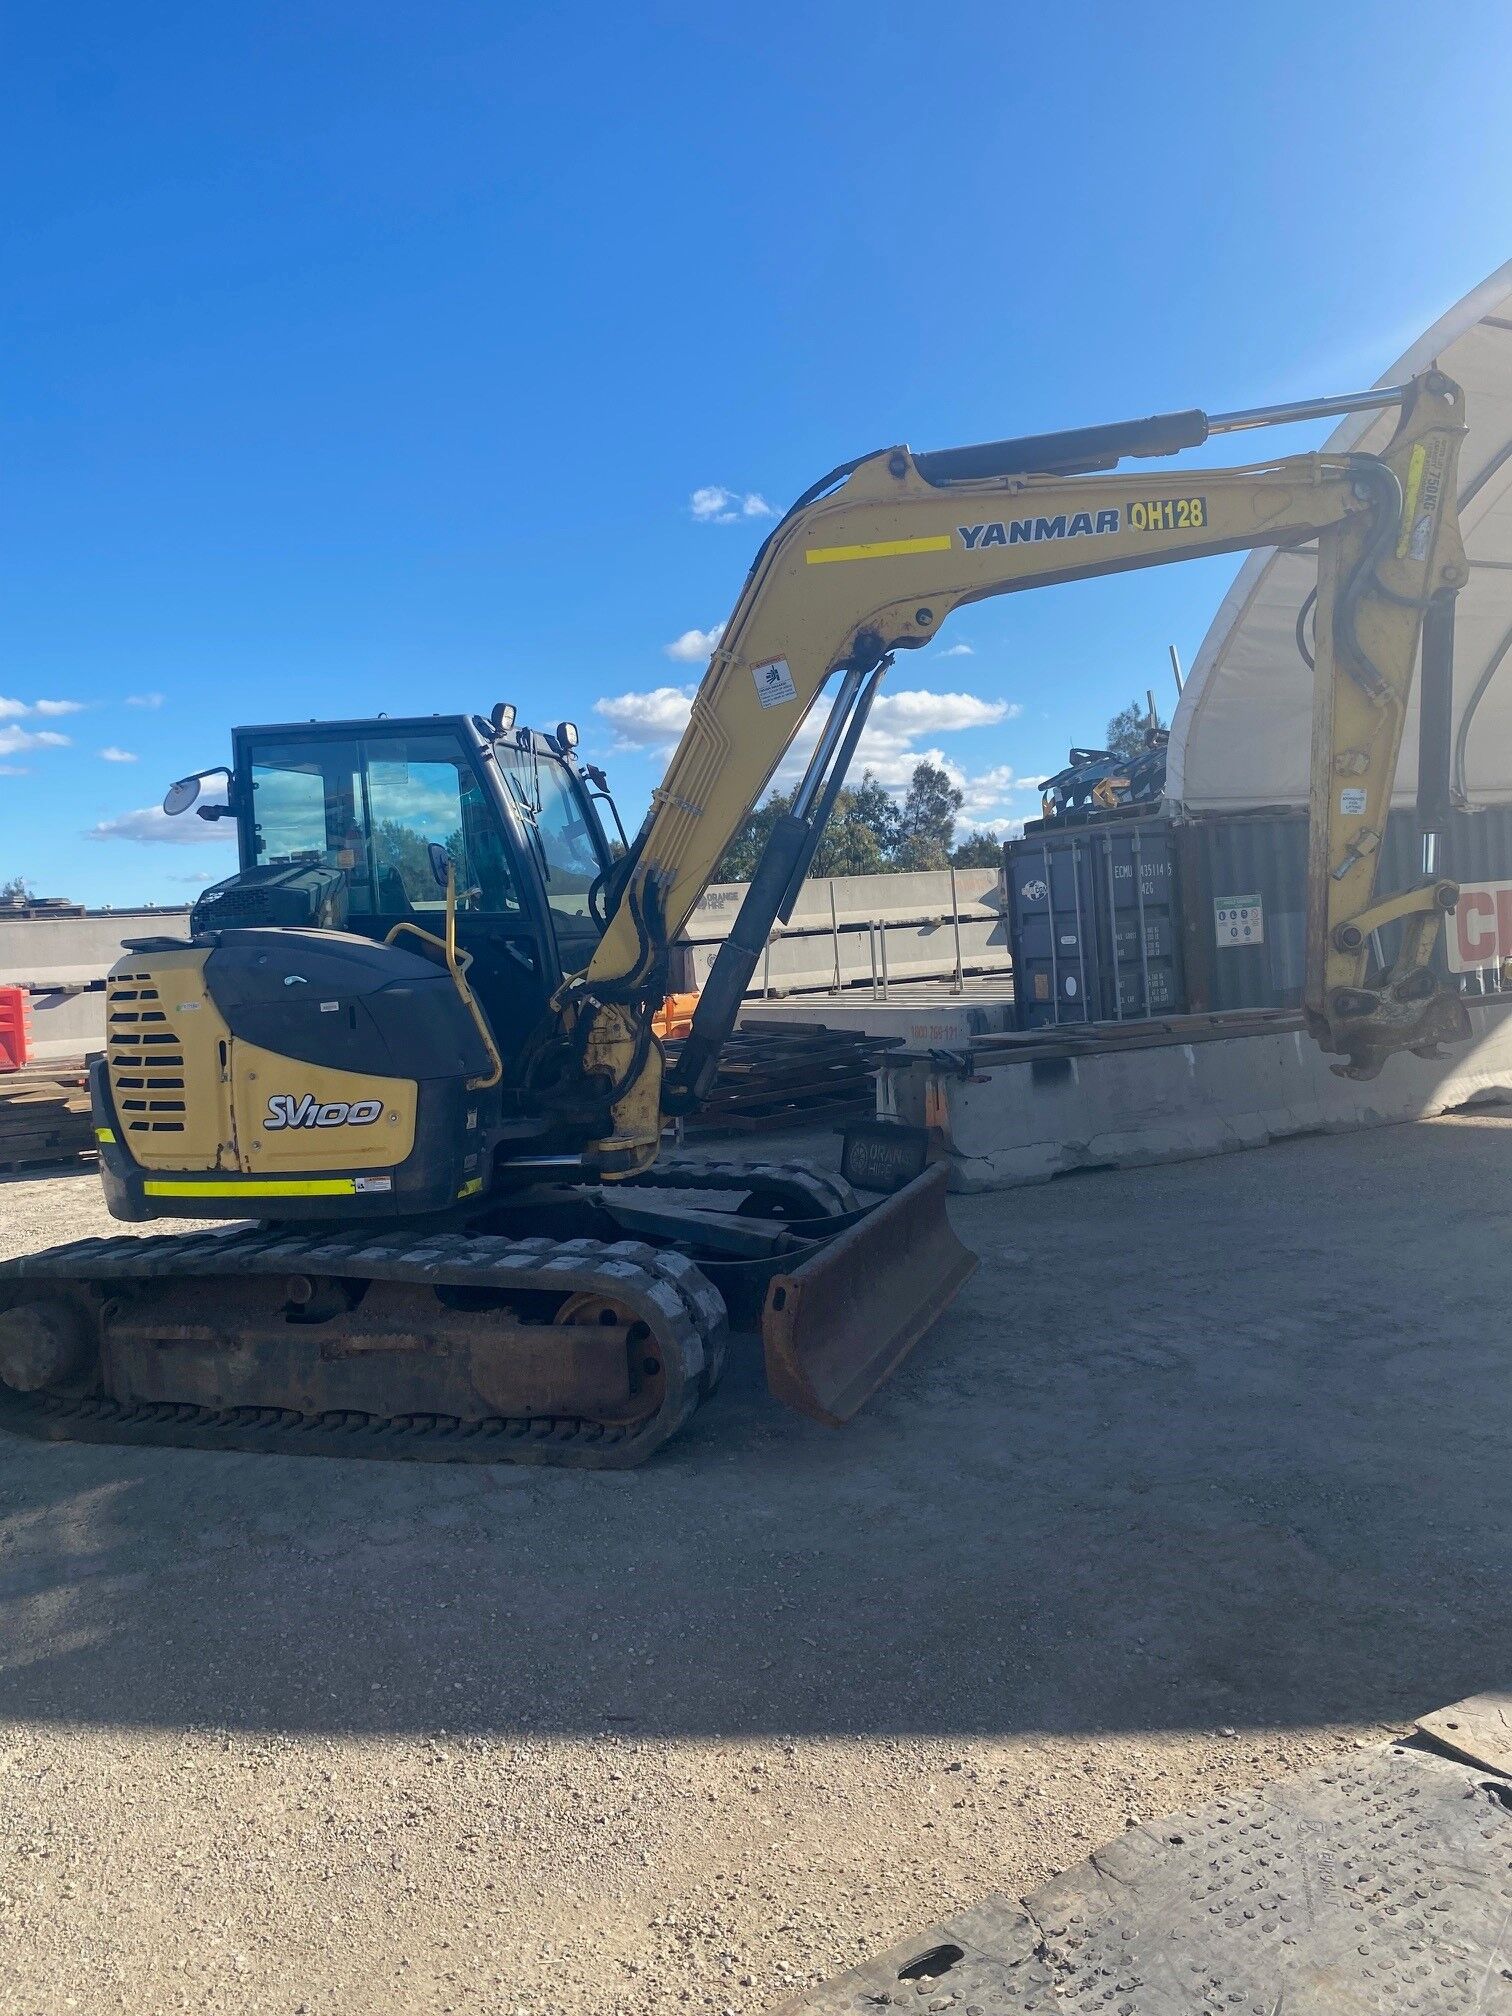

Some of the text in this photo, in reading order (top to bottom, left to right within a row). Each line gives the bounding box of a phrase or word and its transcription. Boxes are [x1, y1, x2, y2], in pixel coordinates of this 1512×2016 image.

[1424, 471, 1441, 511] 750KG
[958, 509, 1119, 549] YANMAR
[1114, 864, 1133, 878] ECMU
[706, 892, 738, 901] ORANGE
[708, 900, 725, 909] HIRE
[263, 1094, 383, 1130] SV100
